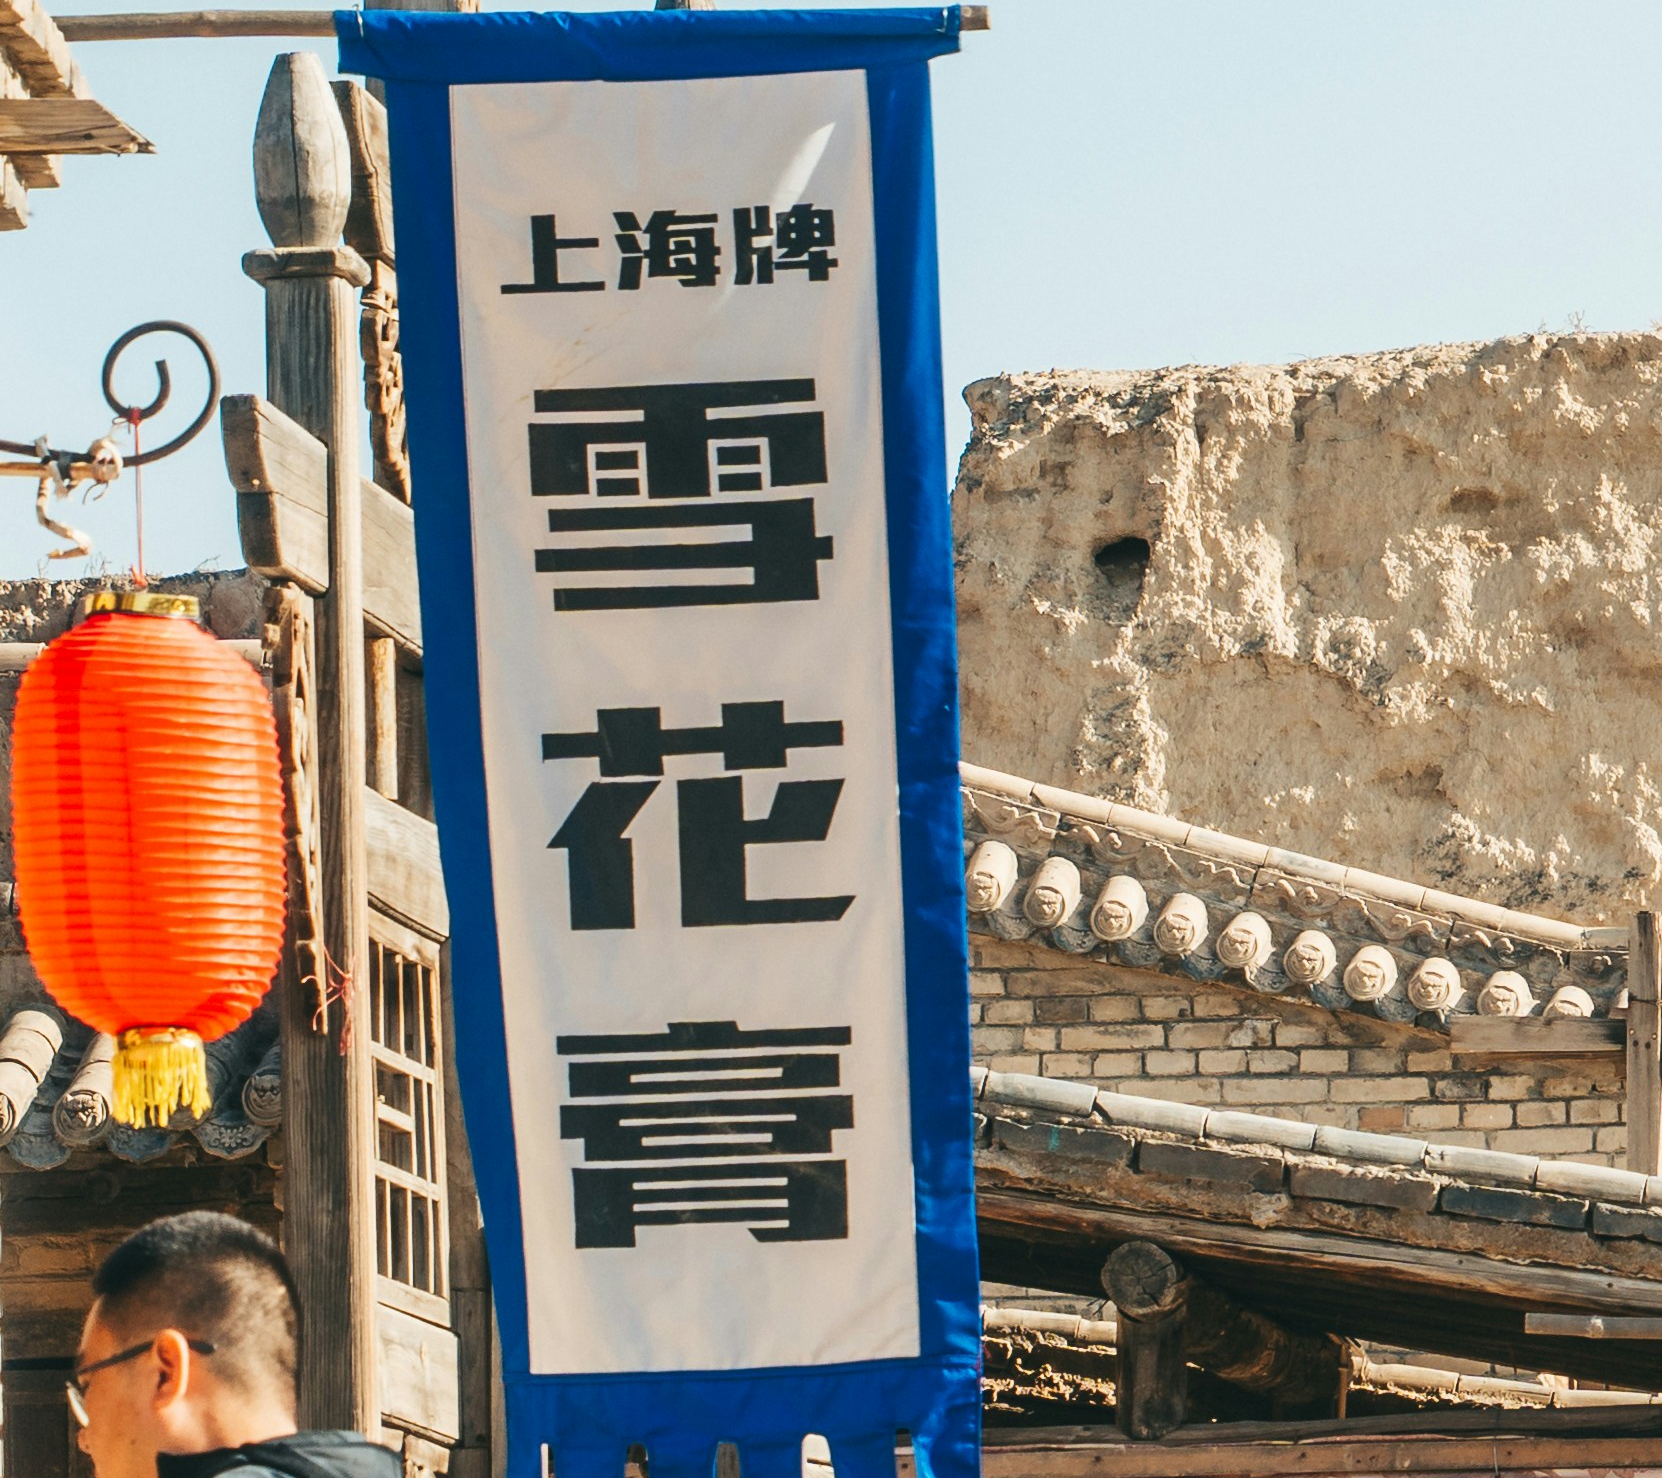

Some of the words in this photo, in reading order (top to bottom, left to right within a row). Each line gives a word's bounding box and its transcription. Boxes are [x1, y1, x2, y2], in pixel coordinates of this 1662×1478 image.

[500, 203, 839, 295] 上海牌
[528, 377, 857, 1250] 雪花膏
